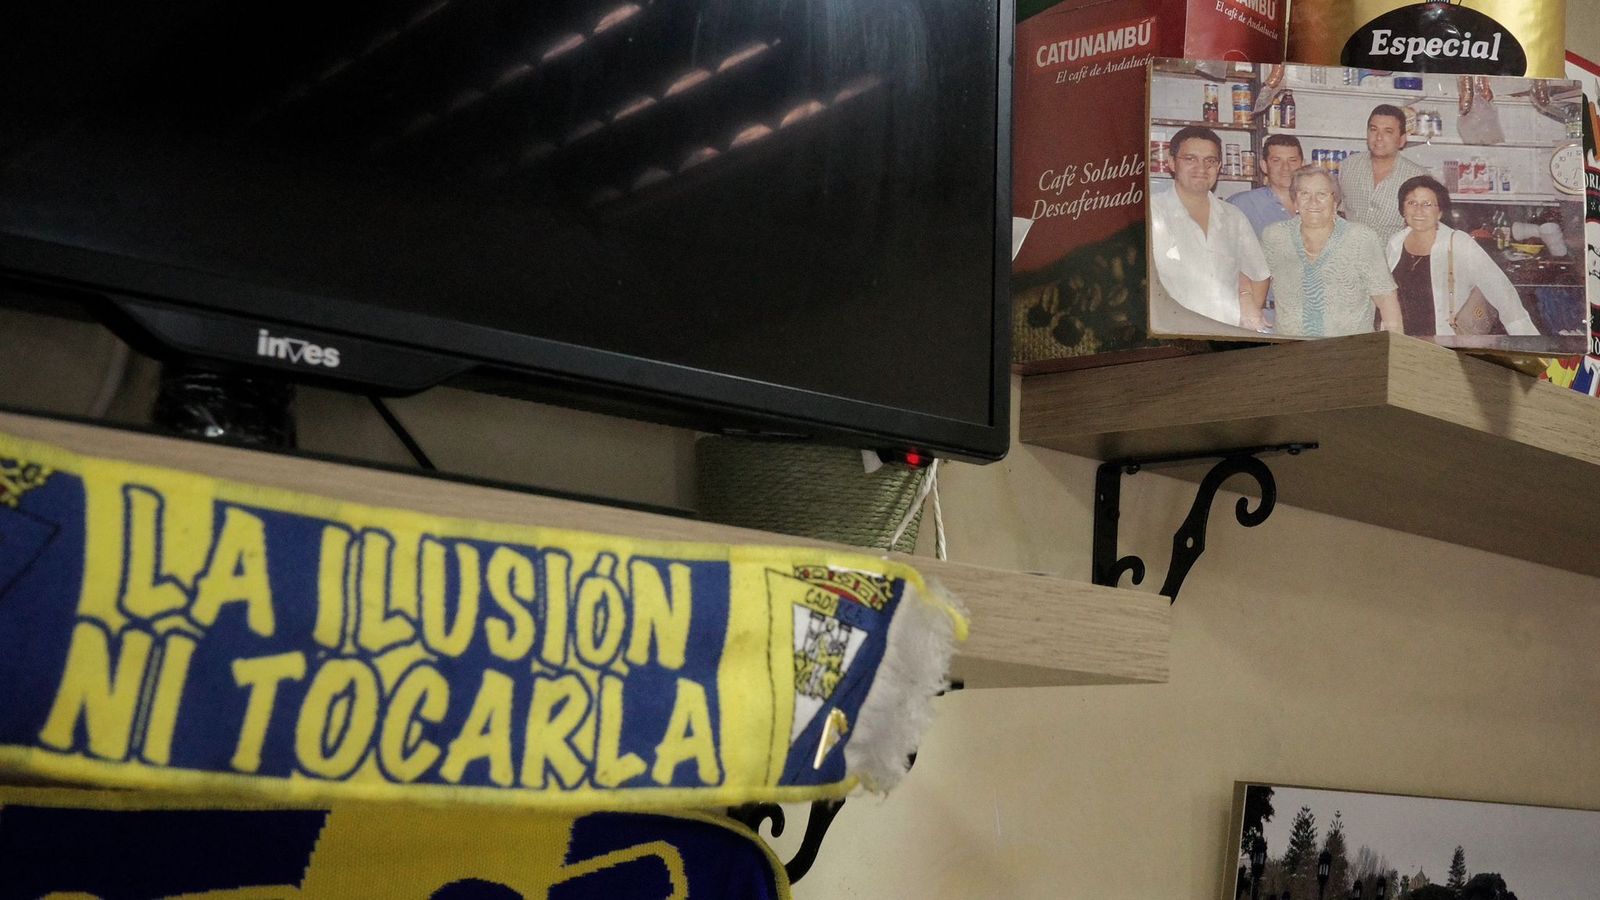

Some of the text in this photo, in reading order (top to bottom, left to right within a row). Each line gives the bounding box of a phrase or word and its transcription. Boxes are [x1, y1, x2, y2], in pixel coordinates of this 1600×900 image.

[1215, 0, 1224, 13] El
[1224, 7, 1238, 21] café
[1238, 12, 1246, 24] de
[1036, 18, 1152, 68] CATUNAMBÚ
[1368, 29, 1502, 64] Especial
[1055, 70, 1067, 84] El
[1068, 65, 1088, 84] café
[1089, 63, 1102, 77] de
[1038, 153, 1146, 196] Café Soluble
[1031, 182, 1144, 221] Descafeinado
[257, 328, 340, 368] inves
[118, 483, 692, 672] LA ILUSIÓN
[38, 620, 724, 790] NI TOCARLA
